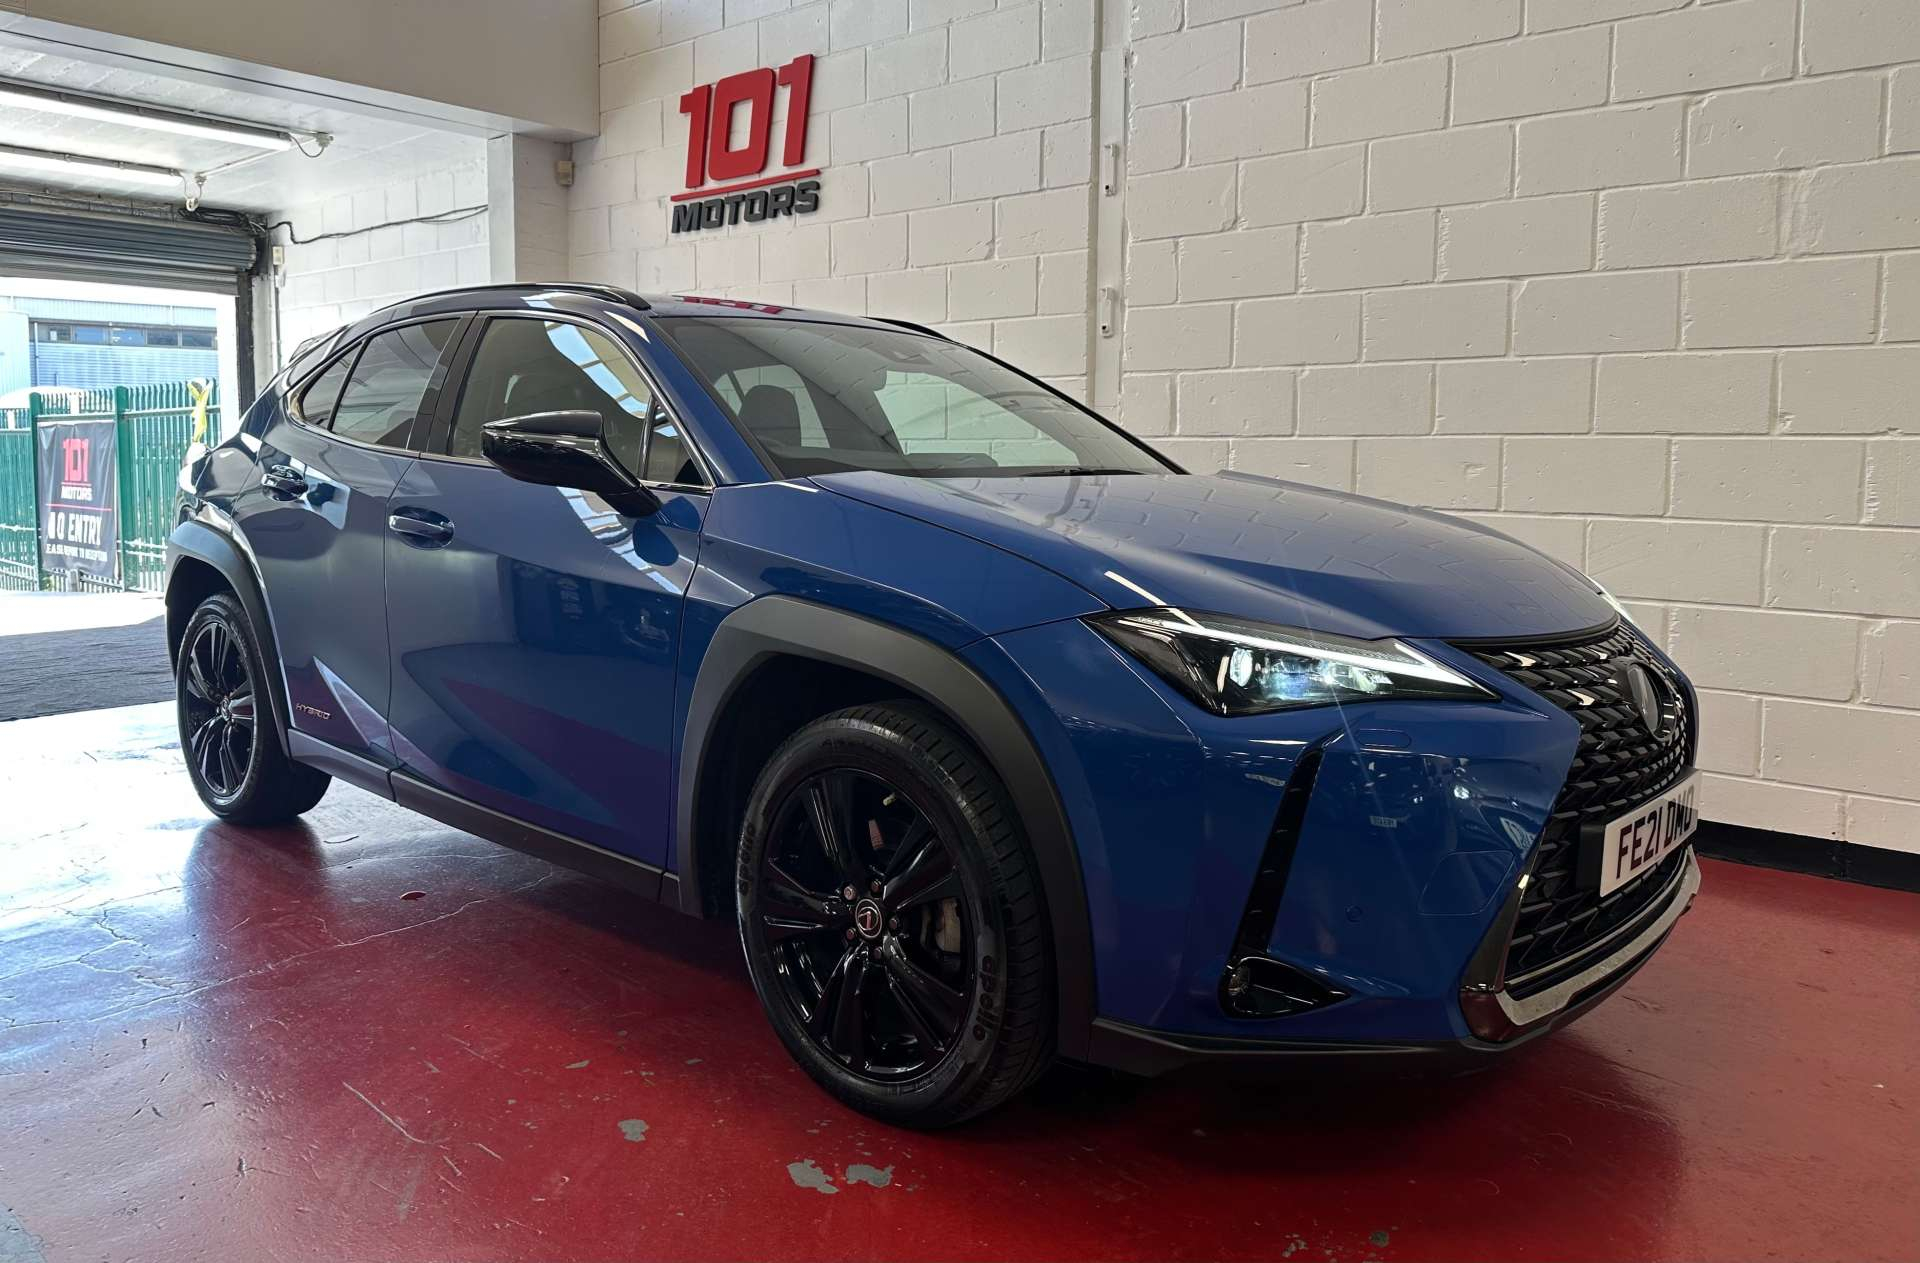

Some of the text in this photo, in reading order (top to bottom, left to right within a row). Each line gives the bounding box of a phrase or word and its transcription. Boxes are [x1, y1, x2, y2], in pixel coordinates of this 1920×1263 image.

[680, 54, 814, 189] 101
[671, 181, 820, 233] MOTORS
[63, 438, 89, 482] 101
[68, 513, 102, 546] ENTRY
[296, 703, 330, 720] HYBRID
[1616, 785, 1695, 880] FE21 DMO
